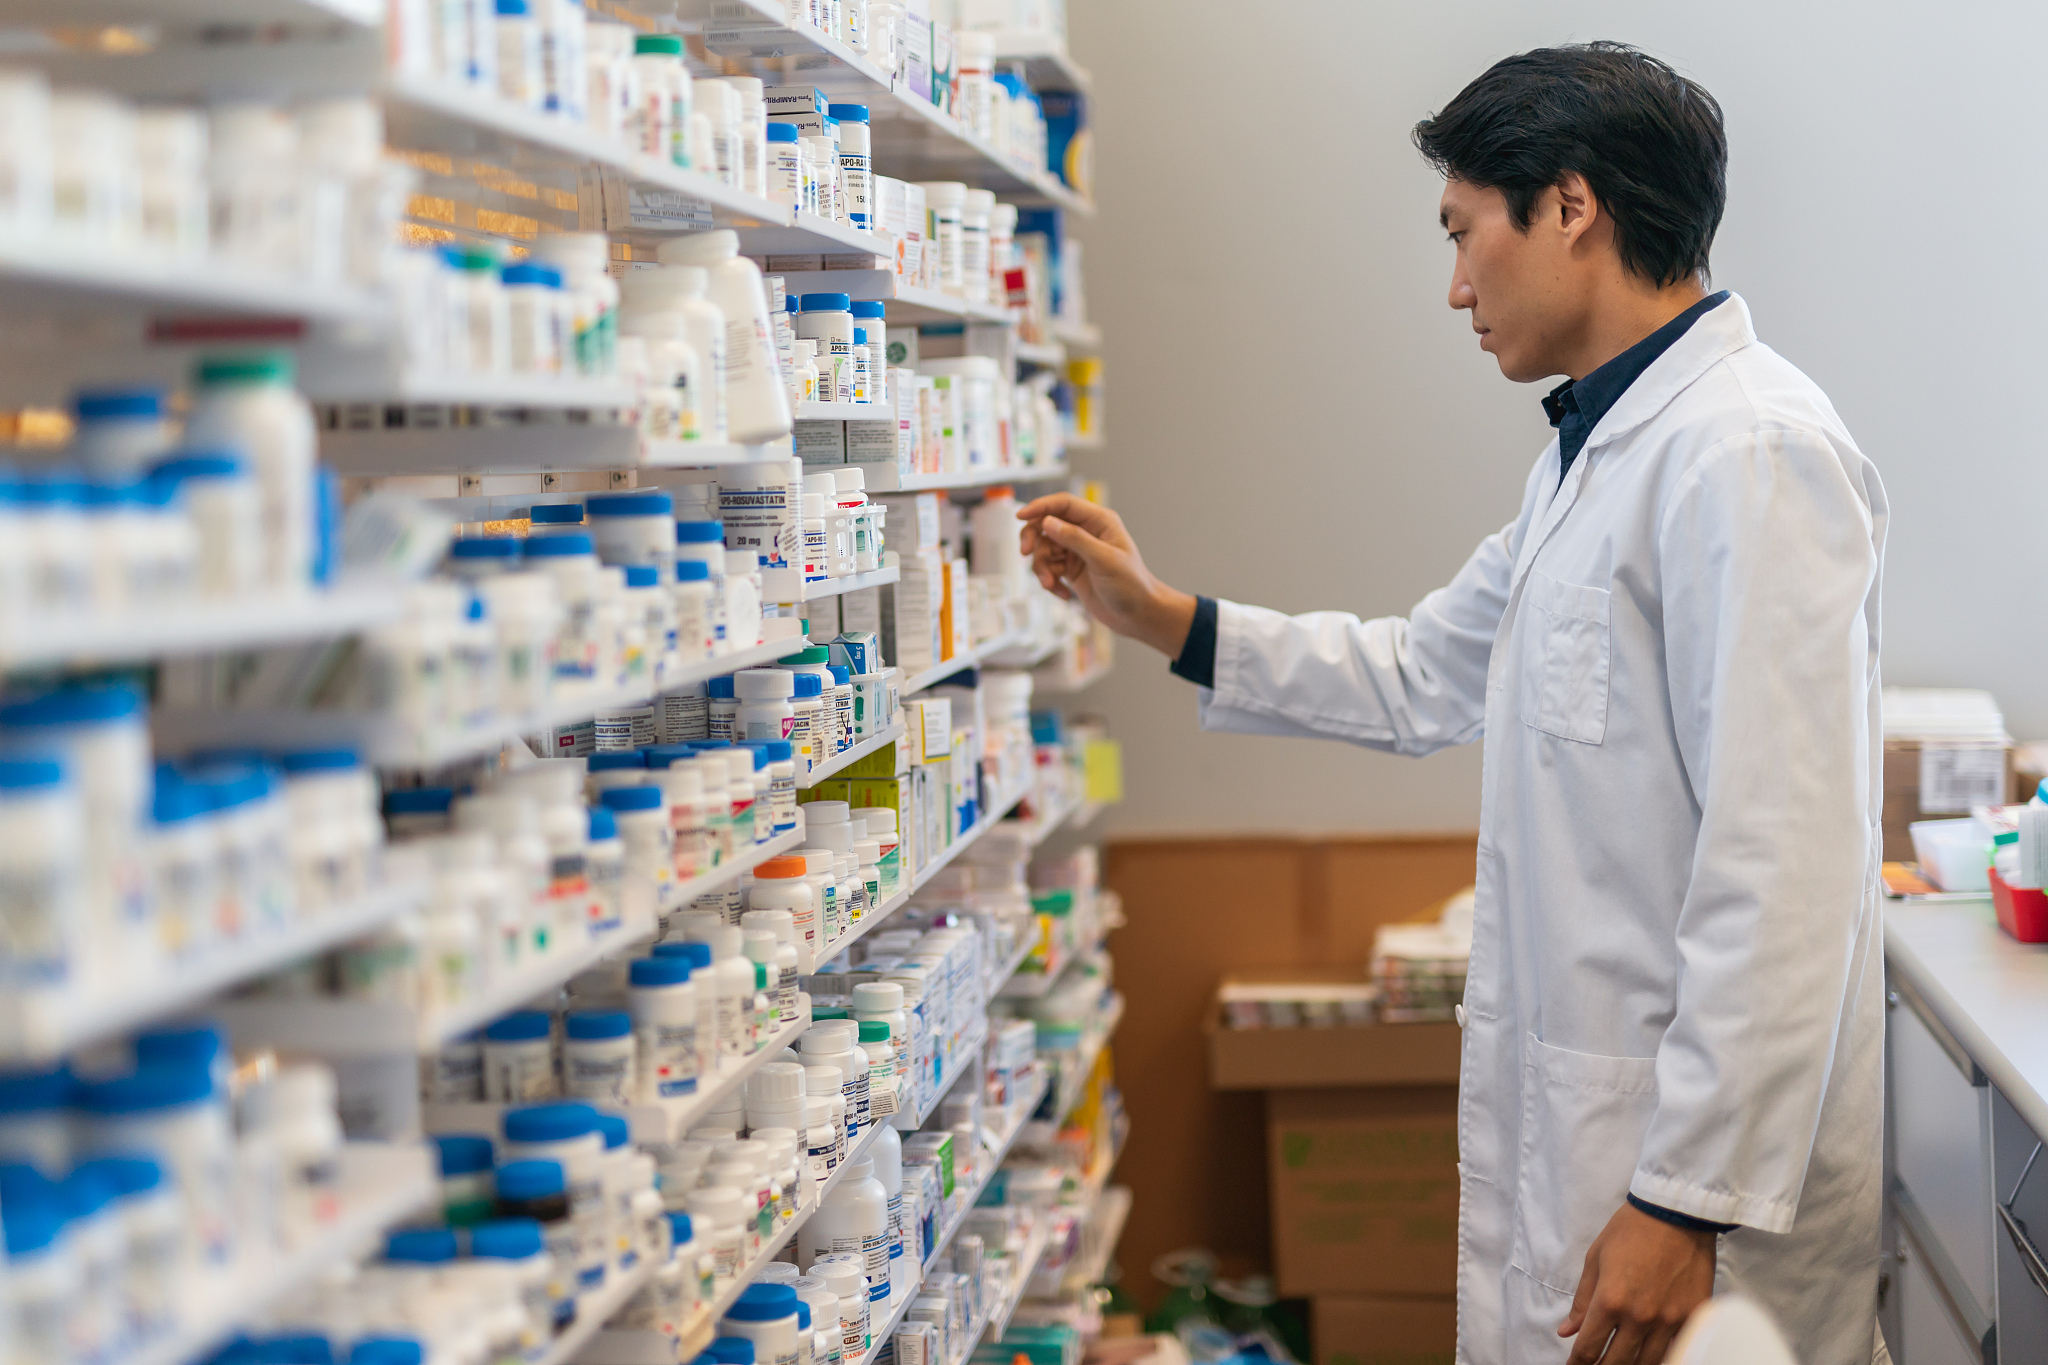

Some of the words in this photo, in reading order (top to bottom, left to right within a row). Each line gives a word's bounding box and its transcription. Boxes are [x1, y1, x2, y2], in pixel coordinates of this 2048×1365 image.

[840, 158, 867, 166] APO-RA
[737, 536, 746, 545] 20
[748, 538, 761, 546] mg
[854, 651, 861, 660] mg
